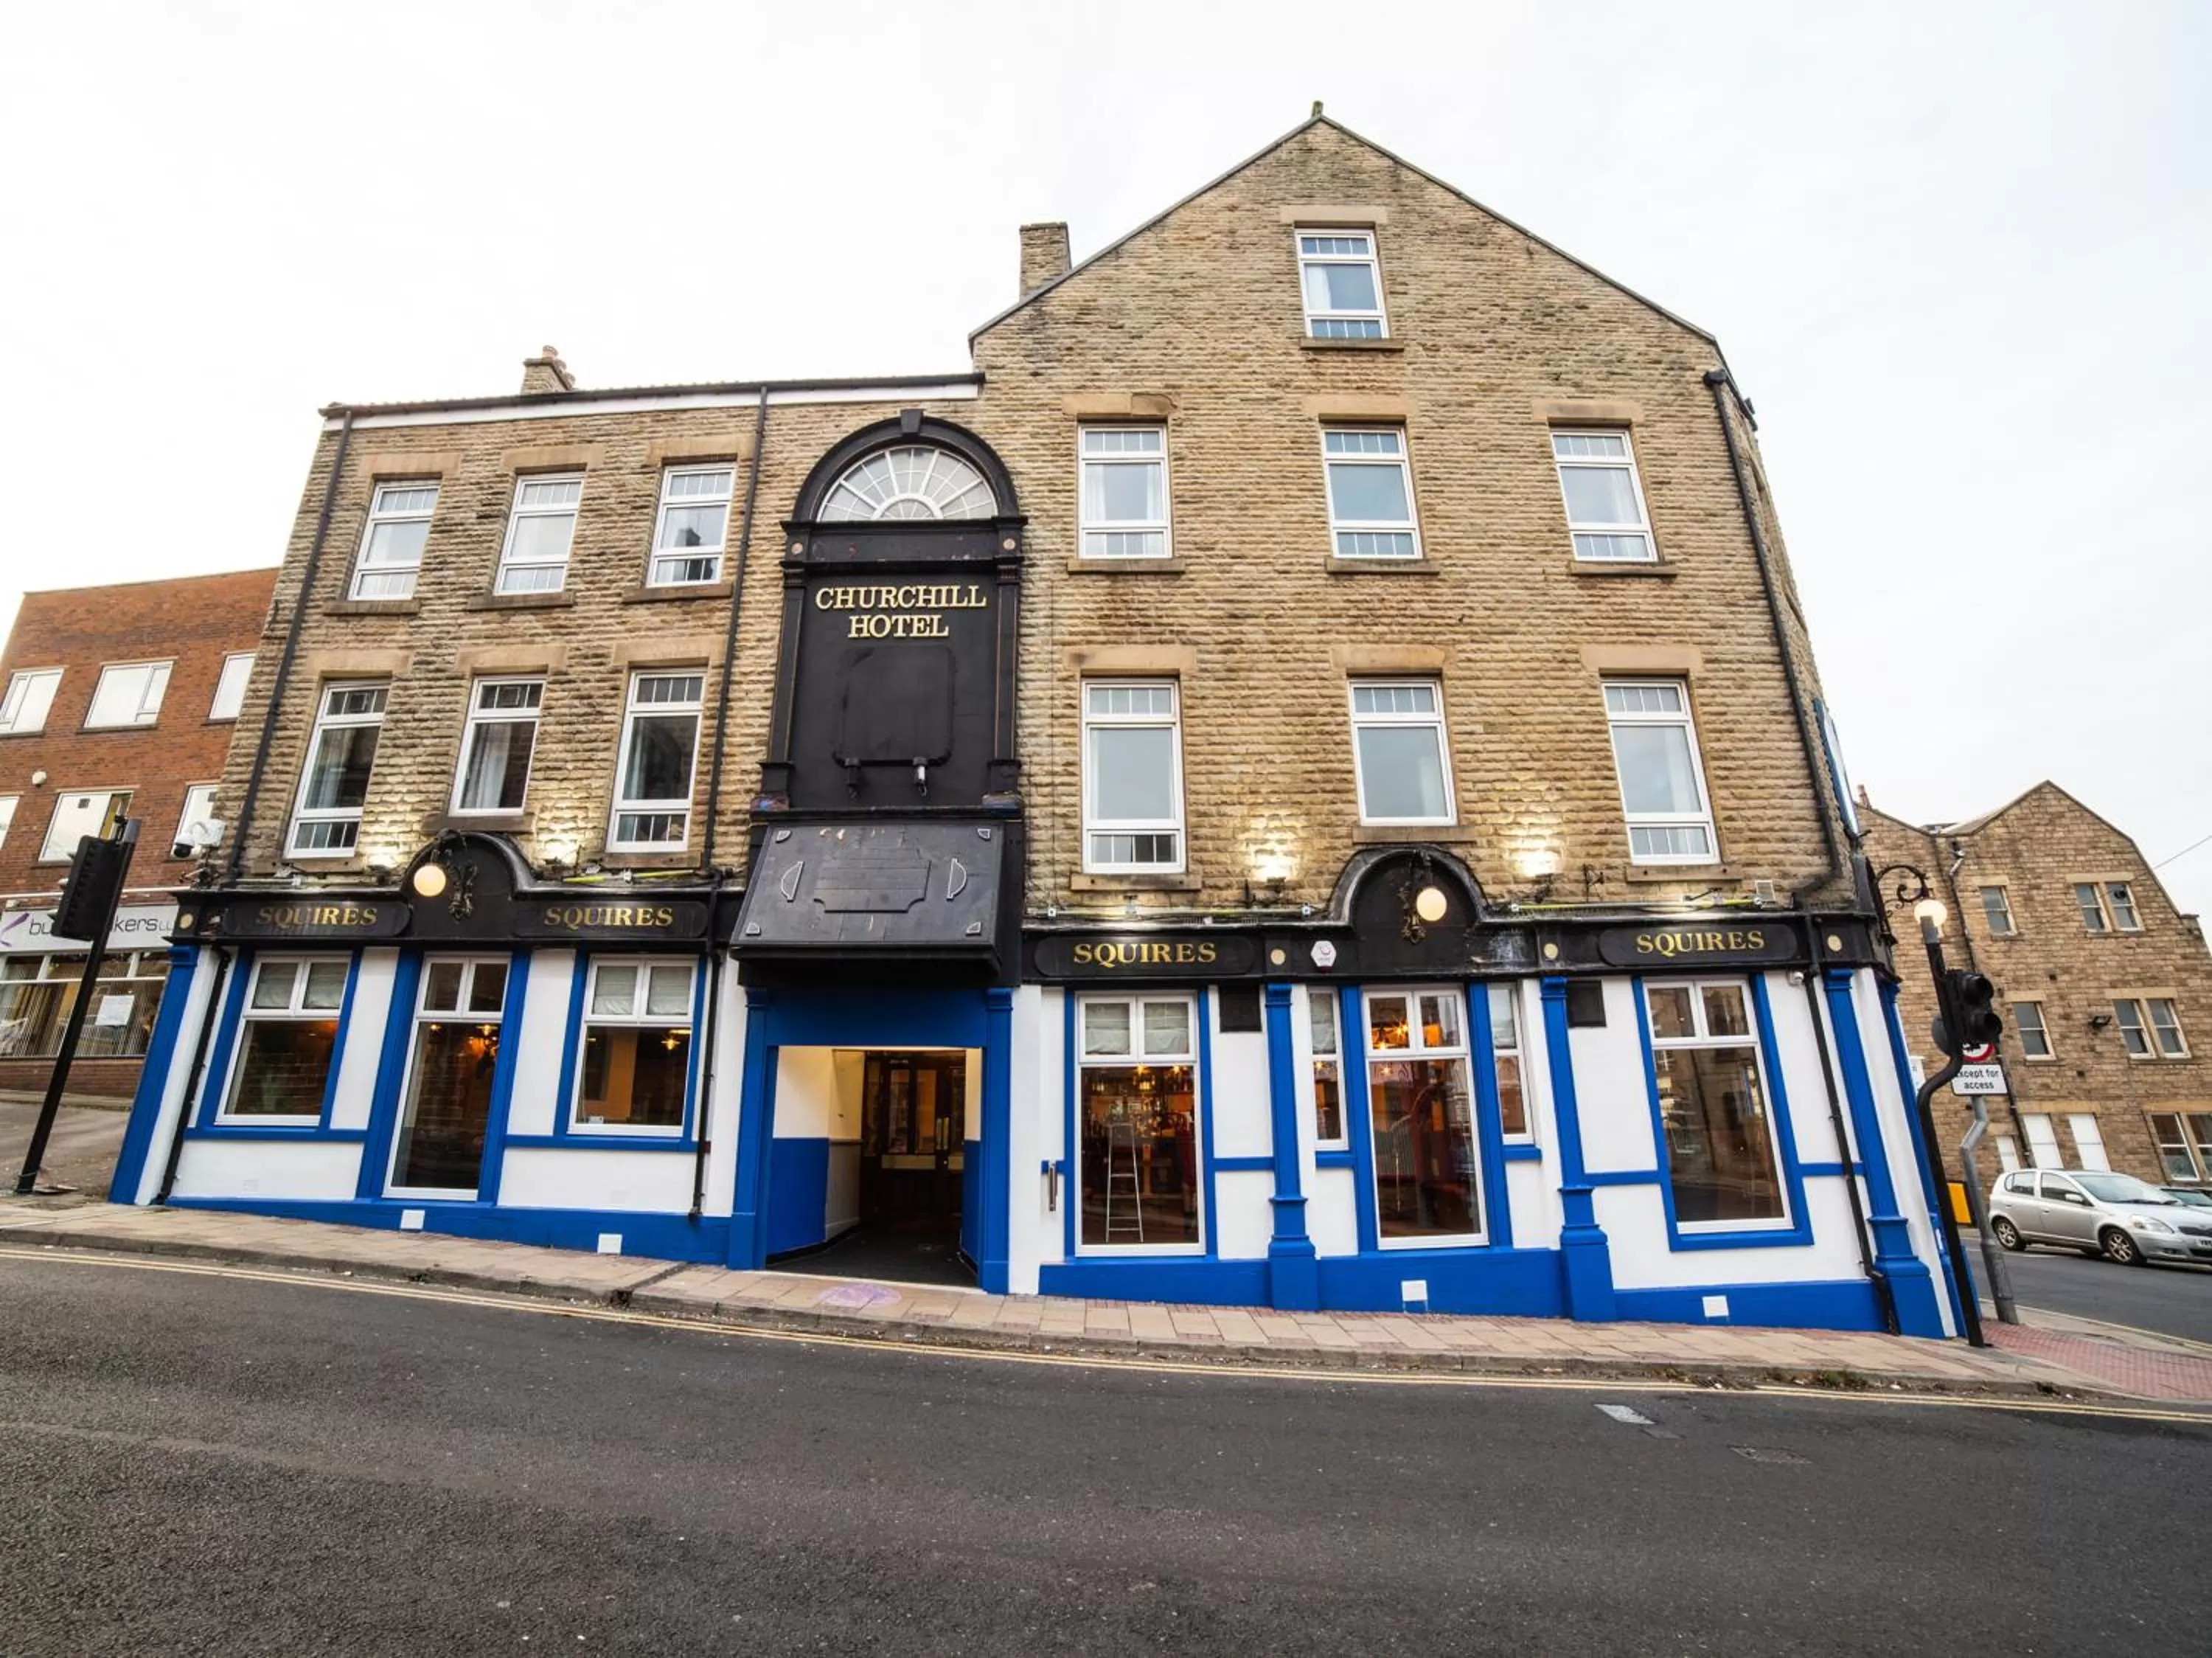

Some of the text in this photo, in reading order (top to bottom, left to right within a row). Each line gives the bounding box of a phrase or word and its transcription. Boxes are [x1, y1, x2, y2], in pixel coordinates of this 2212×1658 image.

[815, 585, 987, 610] CHURCHILL
[848, 614, 950, 639] HOTEL
[257, 907, 378, 929] SQUIRES
[543, 907, 673, 930] SQUIRES
[1074, 941, 1217, 968] SQUIRES
[1635, 930, 1765, 957] SQUIRES
[1957, 1068, 2000, 1078] xcept for
[1964, 1081, 1994, 1090] access
